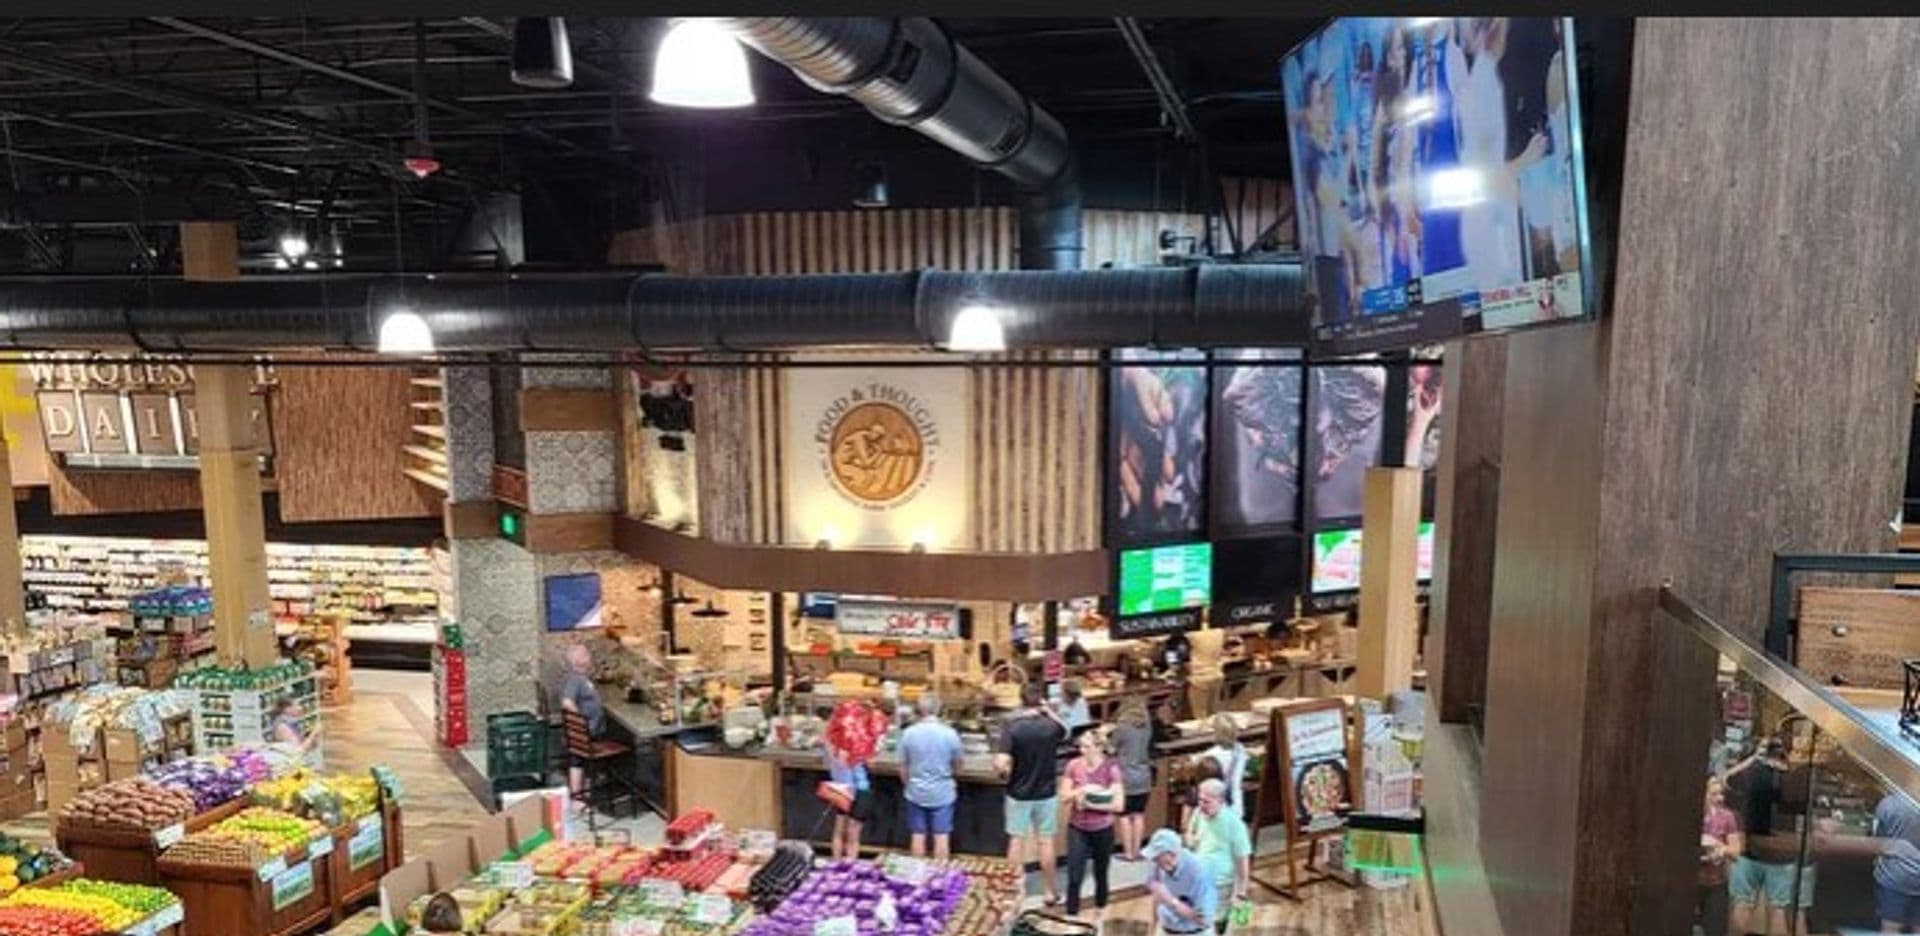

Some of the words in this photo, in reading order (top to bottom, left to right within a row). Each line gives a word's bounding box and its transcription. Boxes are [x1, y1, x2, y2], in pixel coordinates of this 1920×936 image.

[23, 353, 280, 389] WHOLESE
[814, 396, 850, 443] FOOD
[851, 388, 864, 400] &
[869, 383, 940, 446] THOUGHT
